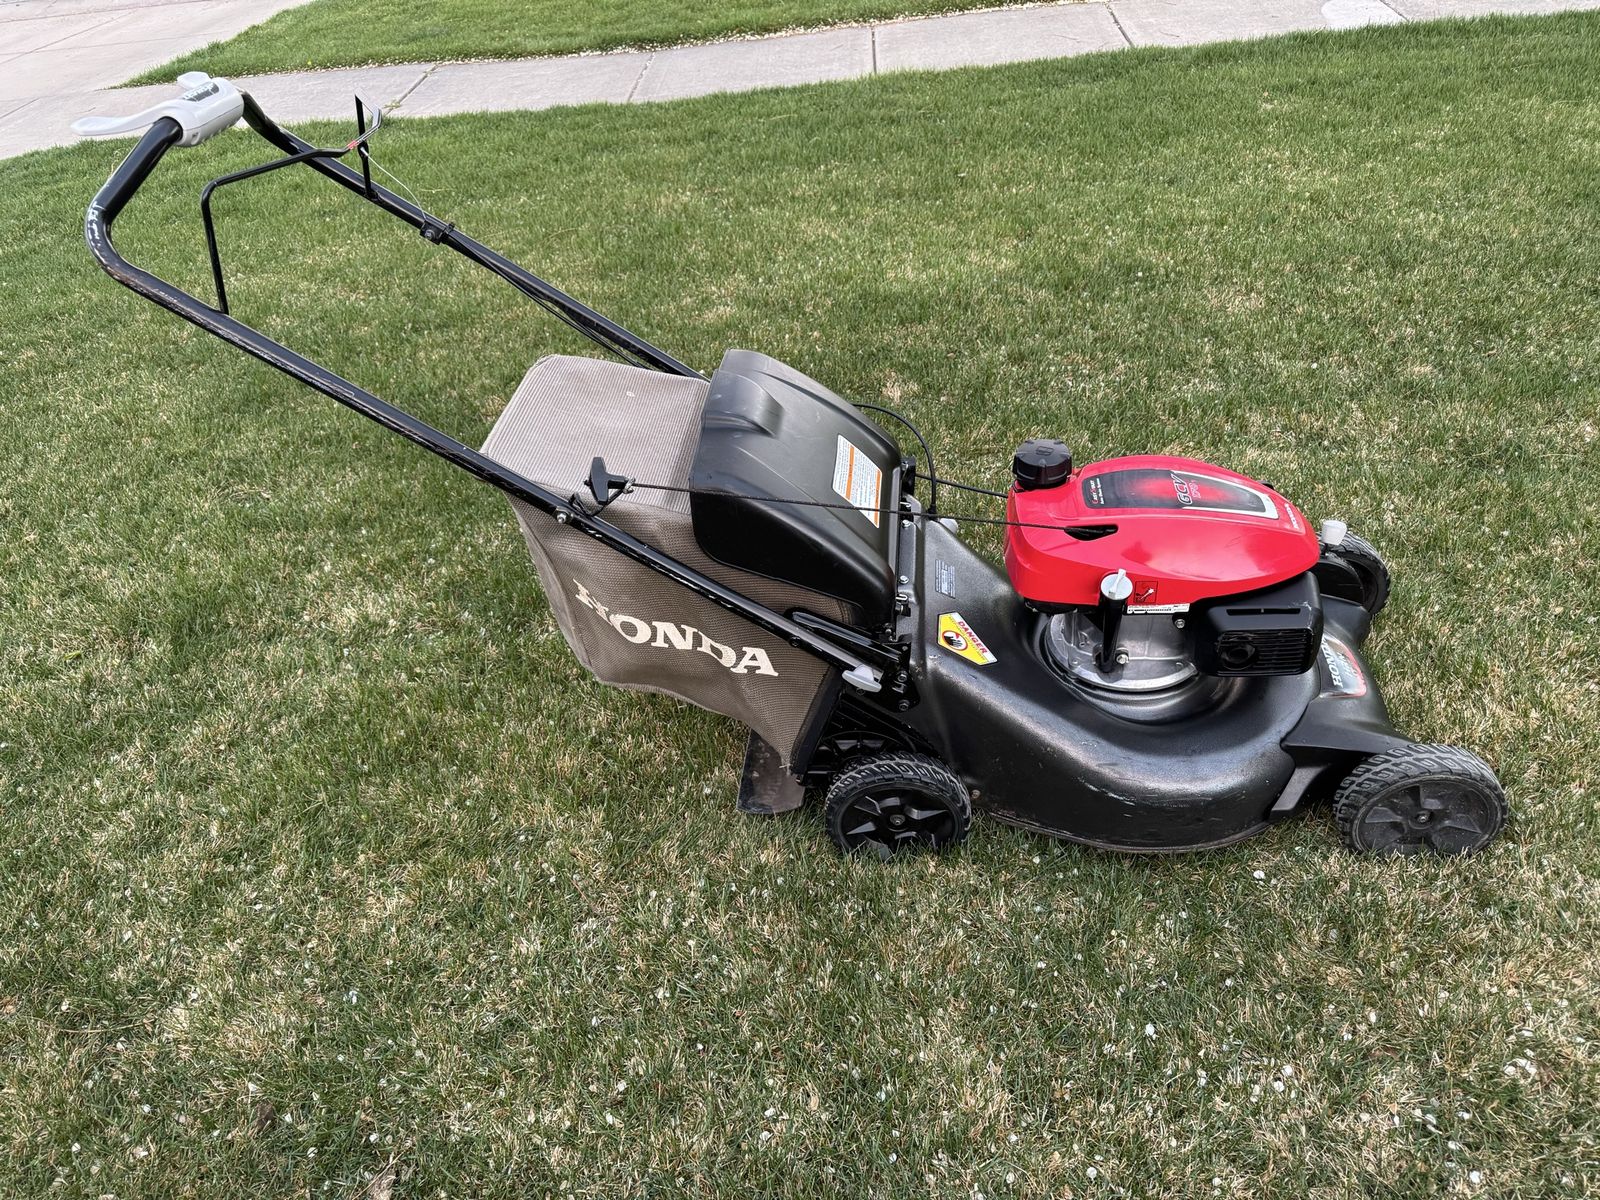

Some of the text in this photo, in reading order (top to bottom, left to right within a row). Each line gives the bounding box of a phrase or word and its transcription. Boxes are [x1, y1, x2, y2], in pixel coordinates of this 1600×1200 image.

[1170, 473, 1192, 505] GCV
[573, 578, 779, 677] HONDA
[958, 621, 988, 654] DANGER
